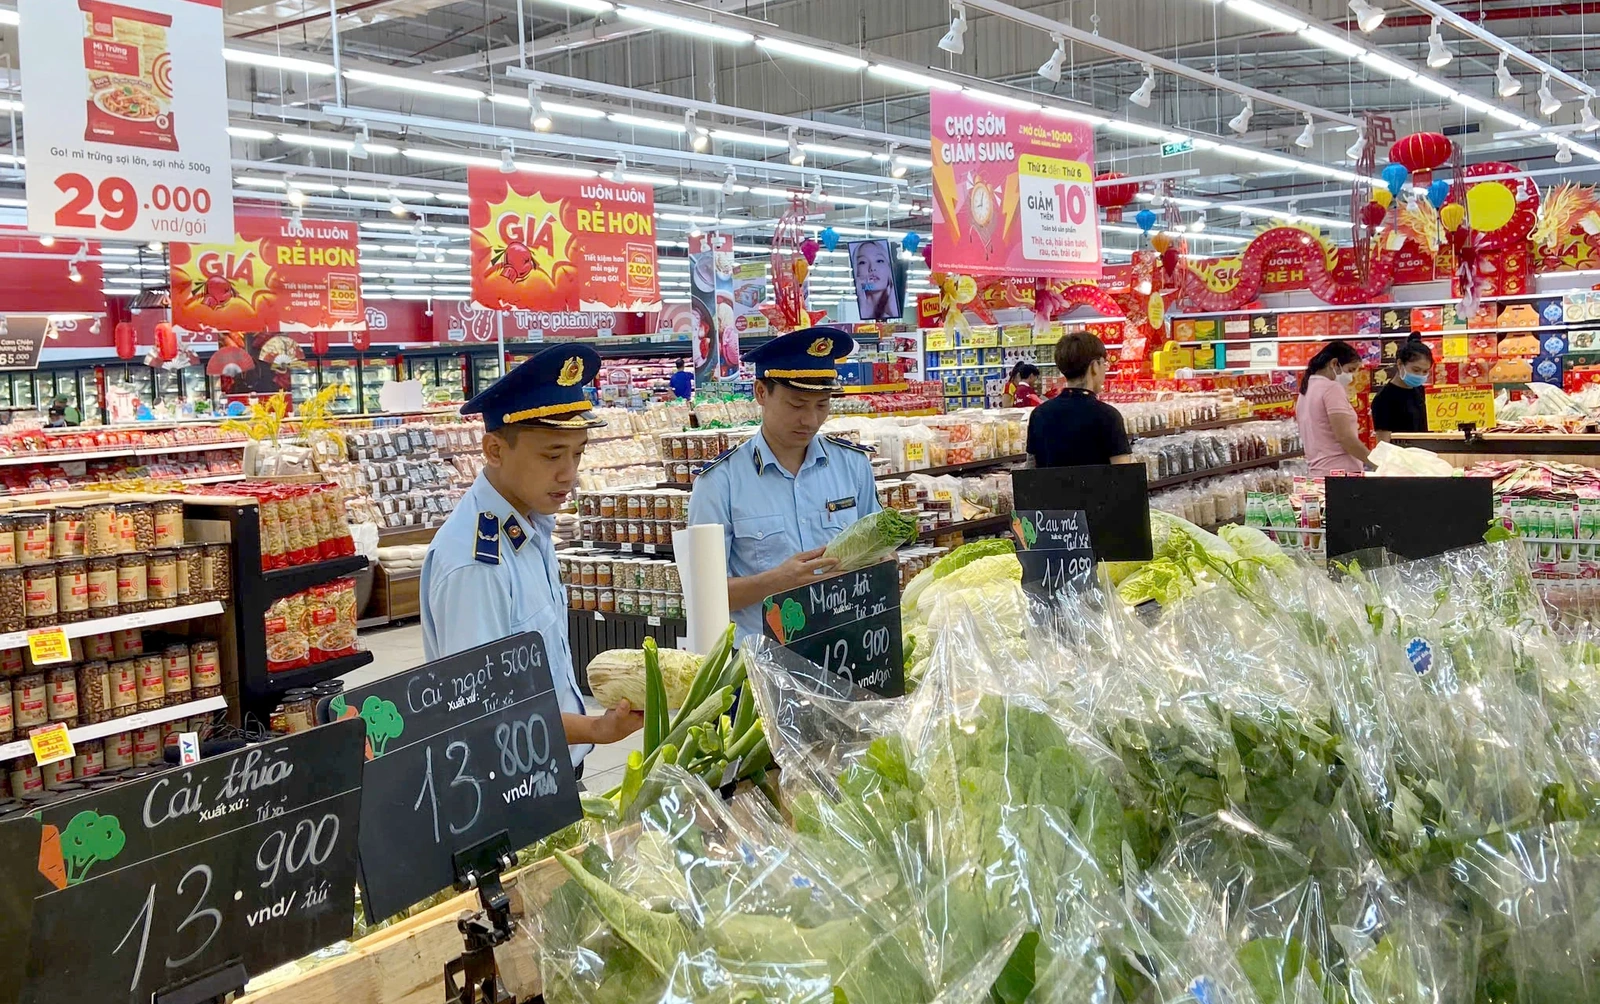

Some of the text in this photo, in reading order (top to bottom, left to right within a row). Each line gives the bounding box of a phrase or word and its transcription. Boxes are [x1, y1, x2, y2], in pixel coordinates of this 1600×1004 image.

[945, 111, 1006, 140] CHỢ SỚM
[941, 135, 1015, 163] GIẢM SUNG
[50, 147, 211, 174] Go! mì trứng sợi lớn, sợi nhỏ 500g
[1027, 162, 1082, 177] Thứ 2 đến Thứ 6
[580, 184, 646, 204] LUÔN LUÔN
[1027, 191, 1053, 211] GIẢM
[151, 218, 207, 236] vnd/gói
[577, 202, 653, 236] RẺ HƠN
[317, 227, 349, 240] LUÔN
[498, 211, 558, 257] GIÁ
[277, 240, 356, 267] RẺ HƠN
[597, 255, 612, 263] kiệm
[1269, 257, 1292, 266] UÔN
[198, 250, 255, 287] GIÁ
[590, 263, 603, 271] mỗi
[629, 264, 652, 275] 2.000
[591, 275, 606, 283] cùng
[331, 291, 355, 299] 2.000
[1436, 402, 1458, 418] 69
[1036, 510, 1078, 538] Rau má
[407, 643, 541, 713] Cải ngọt 500G
[447, 695, 465, 712] Xuất
[142, 771, 209, 829] Cải
[199, 801, 227, 823] Xuất
[228, 798, 249, 814] xứ:
